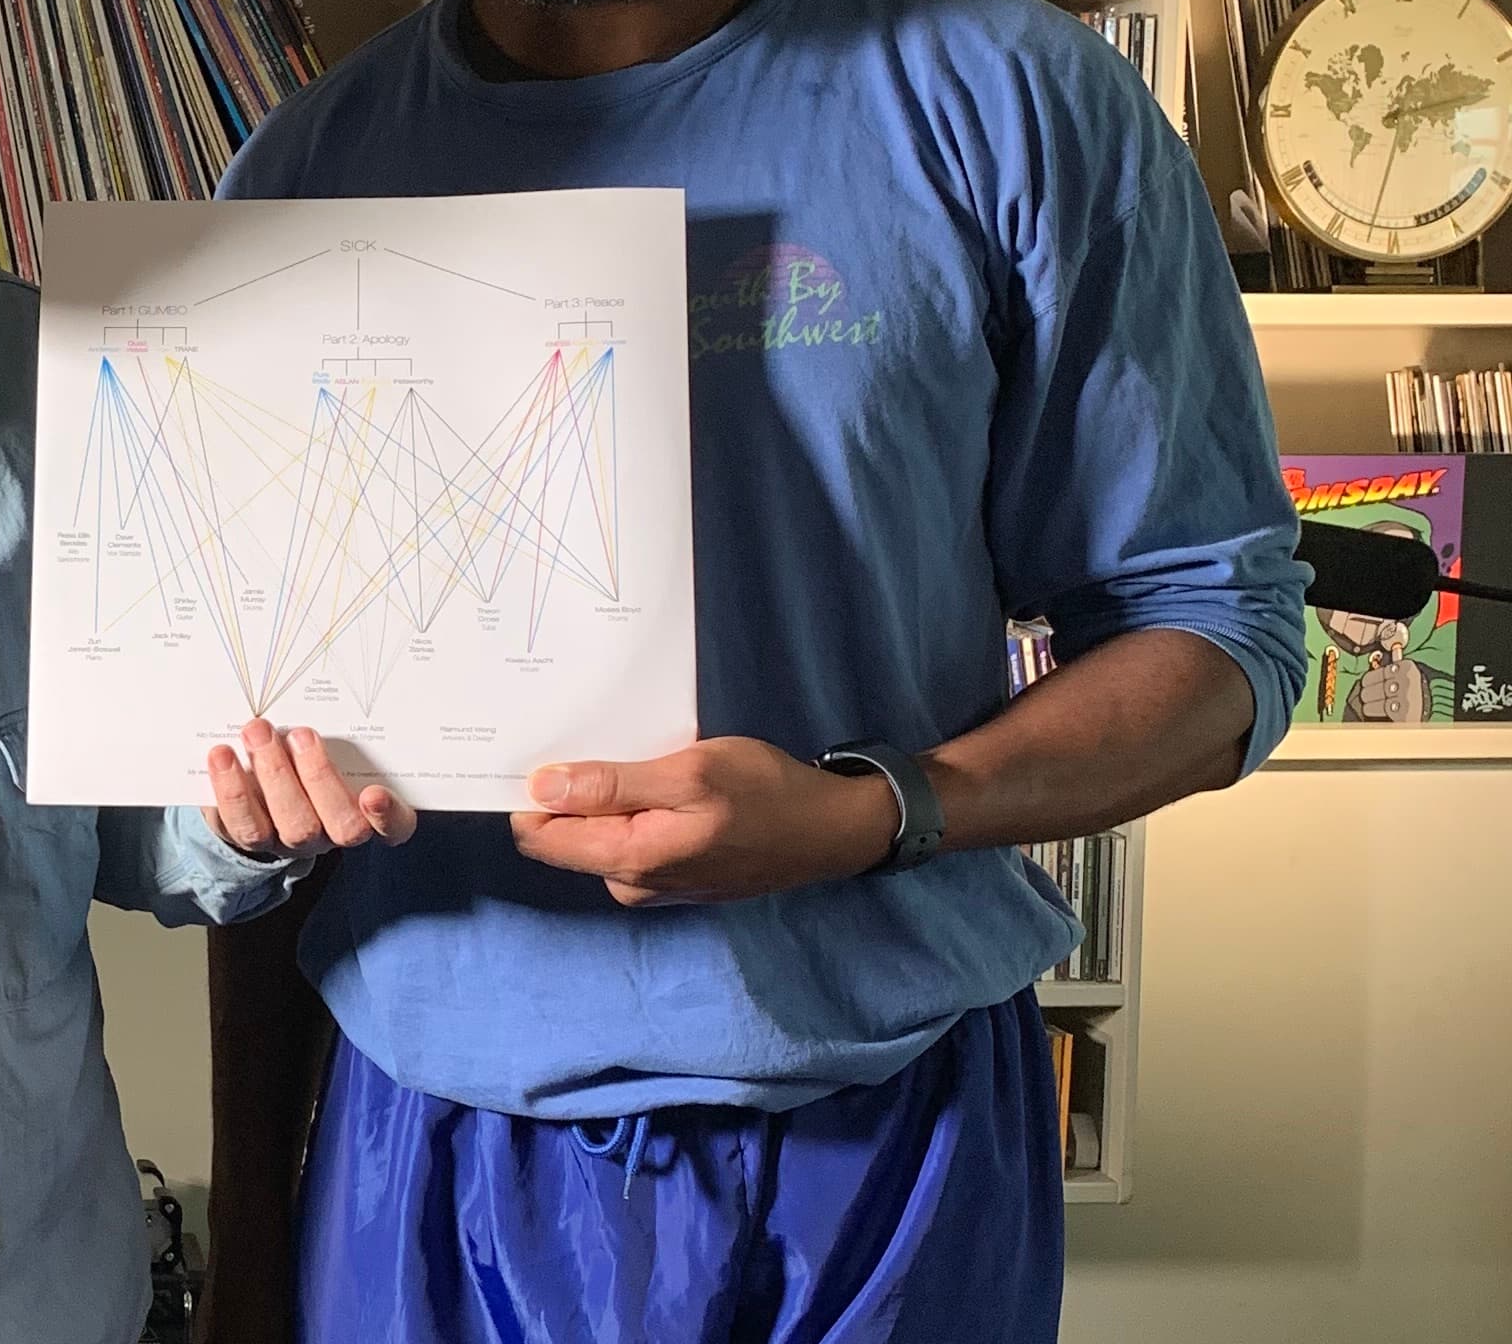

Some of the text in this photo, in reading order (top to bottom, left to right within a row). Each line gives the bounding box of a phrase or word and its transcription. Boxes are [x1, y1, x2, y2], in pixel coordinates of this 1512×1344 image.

[689, 260, 842, 316] outh By
[544, 299, 569, 309] Part
[585, 297, 625, 308] Peace
[101, 305, 125, 316] Part
[138, 305, 189, 316] GUMBO
[690, 306, 886, 359] Southwest
[322, 334, 348, 344] Part
[362, 333, 411, 347] Apology
